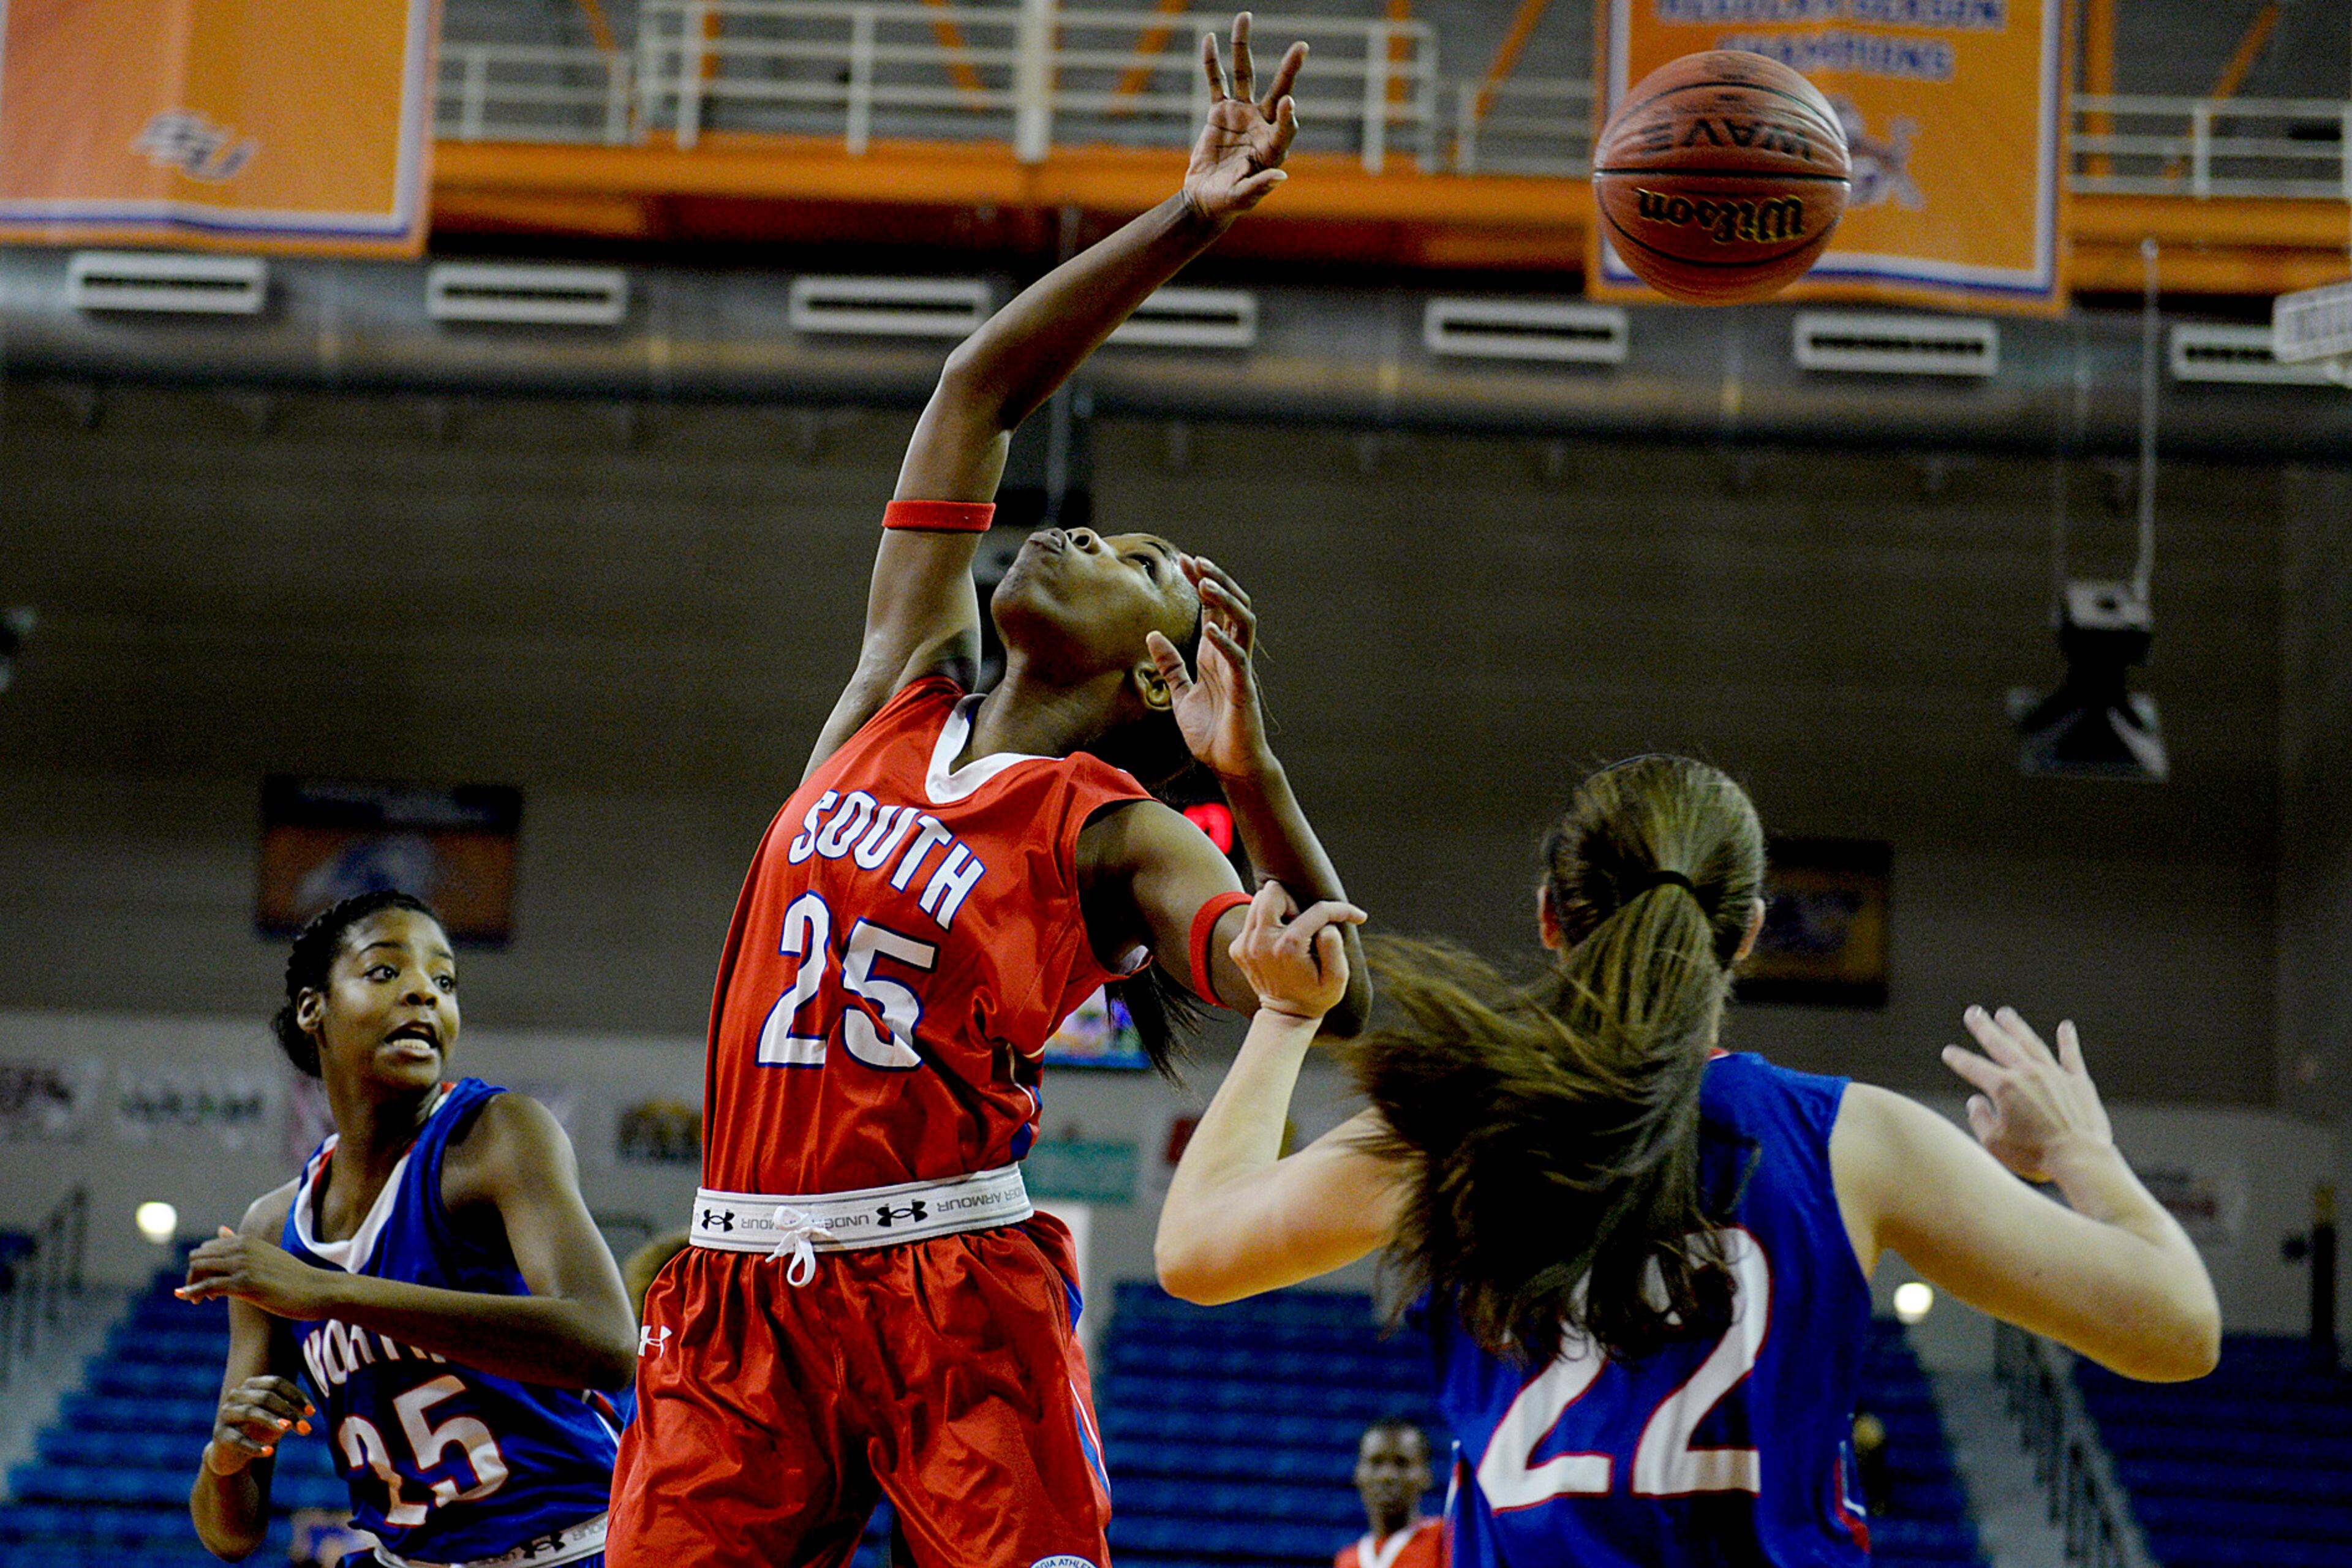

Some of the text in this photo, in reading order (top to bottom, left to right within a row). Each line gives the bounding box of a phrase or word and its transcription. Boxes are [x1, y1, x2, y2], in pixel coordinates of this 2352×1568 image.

[1632, 187, 1806, 245] Wilson
[788, 789, 987, 933] SOUTH
[755, 889, 941, 1072] 25
[937, 1192, 1001, 1212] ARMOUR
[303, 1318, 447, 1398] NOR
[1477, 1223, 1774, 1518] 22
[338, 1374, 509, 1528] 25
